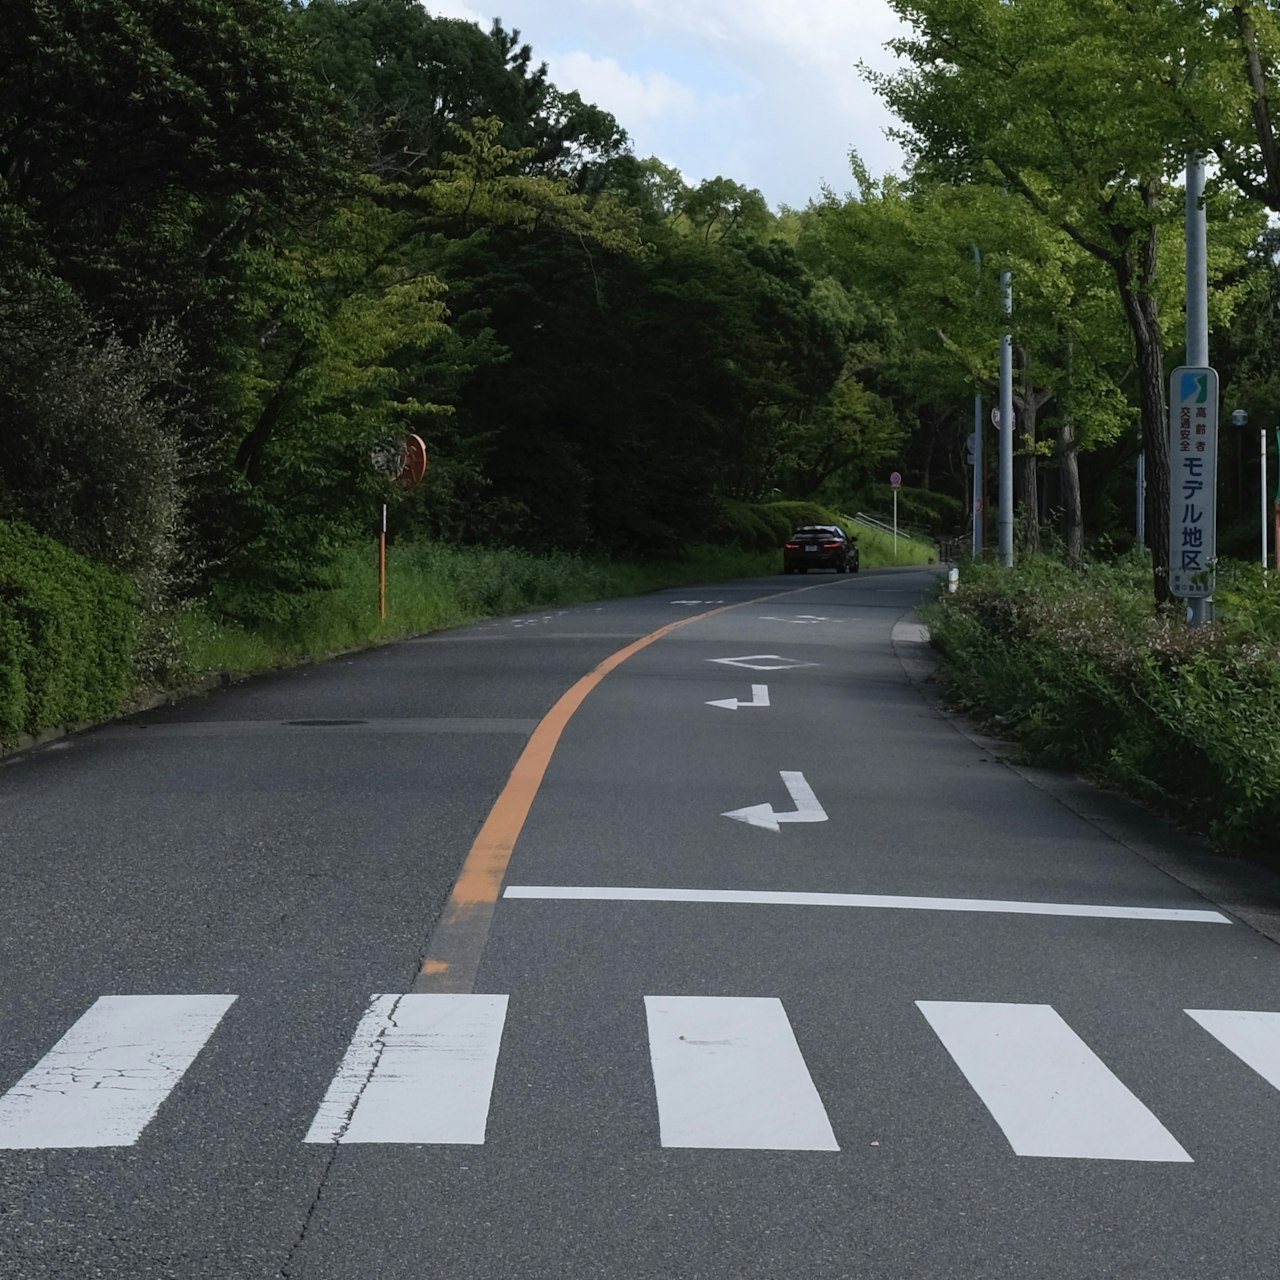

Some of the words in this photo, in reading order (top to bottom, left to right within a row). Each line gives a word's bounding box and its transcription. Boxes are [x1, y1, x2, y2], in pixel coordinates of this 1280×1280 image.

[1180, 407, 1191, 452] 交通安全
[1195, 407, 1207, 452] 高齢者
[1182, 457, 1203, 571] モデル地区
